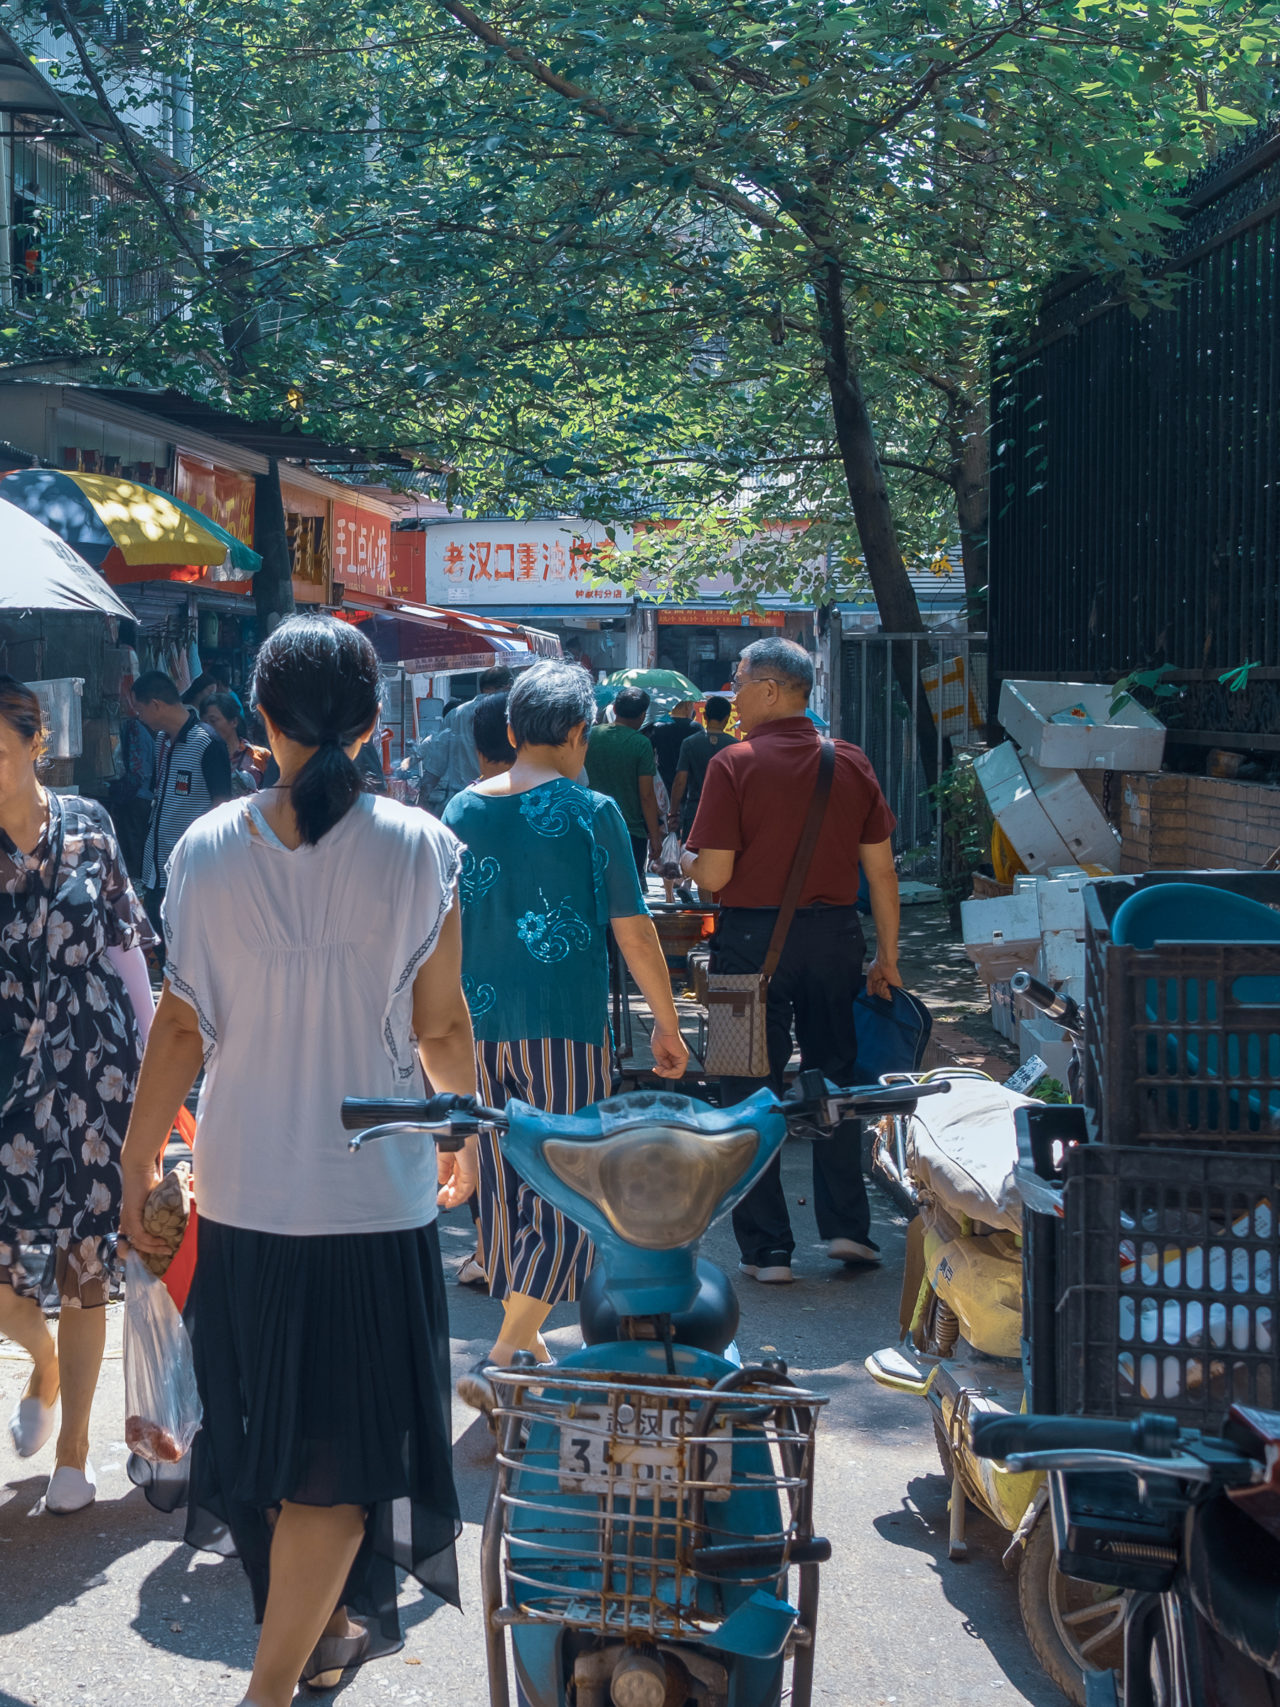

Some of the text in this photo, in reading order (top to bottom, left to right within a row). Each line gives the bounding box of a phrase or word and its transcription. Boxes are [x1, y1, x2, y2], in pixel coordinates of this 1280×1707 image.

[335, 519, 387, 581] 手工点心坊
